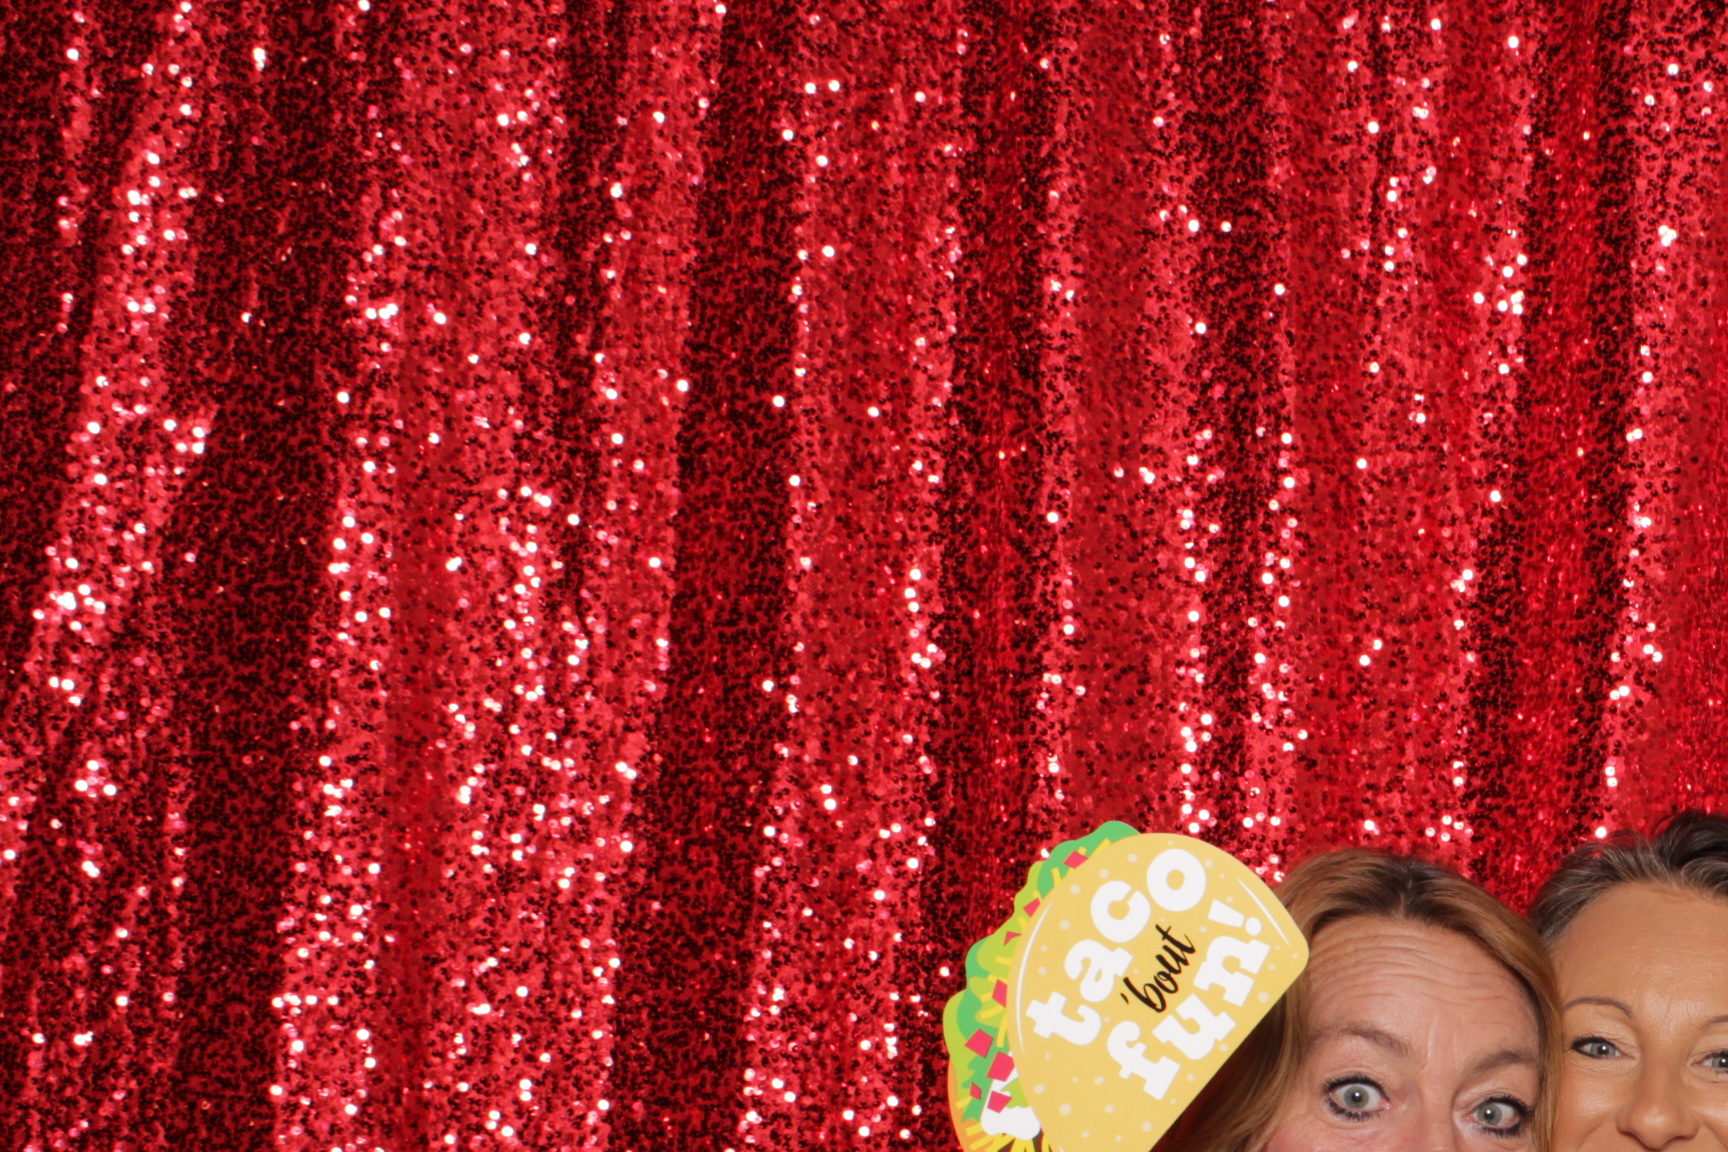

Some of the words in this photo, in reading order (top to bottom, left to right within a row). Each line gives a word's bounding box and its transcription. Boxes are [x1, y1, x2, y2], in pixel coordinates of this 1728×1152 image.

[1026, 849, 1206, 1046] taco
[1106, 899, 1271, 1100] fun!
[1120, 924, 1196, 1013] 'bout
